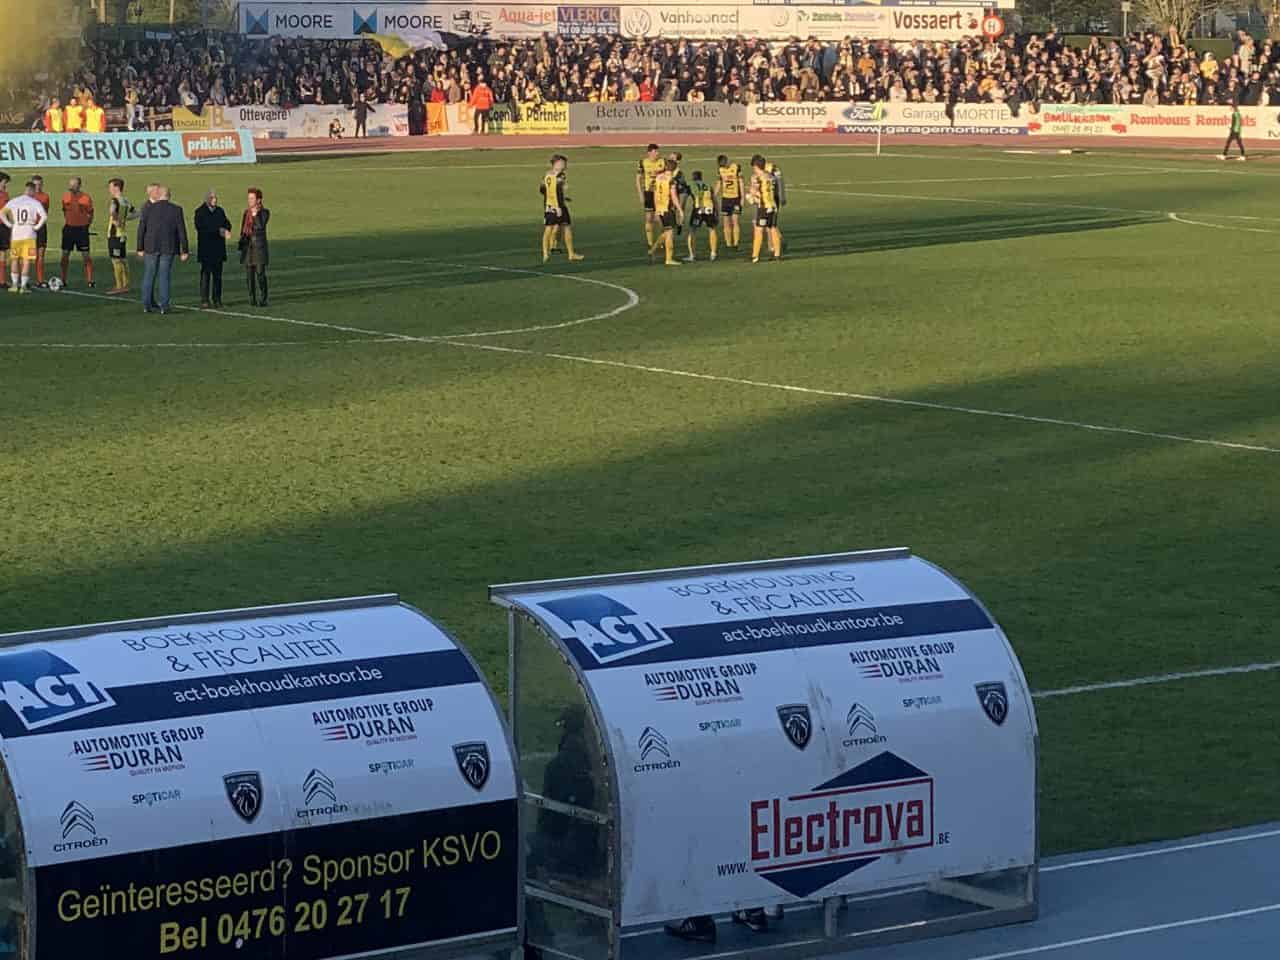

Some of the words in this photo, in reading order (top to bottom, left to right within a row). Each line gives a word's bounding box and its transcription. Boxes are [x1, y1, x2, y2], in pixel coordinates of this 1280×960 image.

[275, 14, 334, 29] MOORE
[384, 15, 443, 29] MOORE
[559, 8, 620, 22] VLERICK
[893, 10, 962, 29] Vossaert
[526, 105, 567, 122] Partners
[596, 104, 633, 119] Beter
[756, 103, 826, 120] descamps
[956, 107, 1010, 121] MORTIE
[1196, 114, 1256, 127] Rombts
[844, 125, 1019, 136] www.garagemortier.be
[32, 140, 58, 162] EN
[69, 138, 172, 161] SERVICES
[16, 208, 29, 223] 10
[670, 570, 856, 598] BOEKHOUDING
[711, 599, 733, 616] &
[736, 586, 865, 614] FISCALITEIT
[122, 619, 337, 652] BOEKHOUDING
[570, 616, 657, 649] ACT
[722, 612, 905, 642] act-boekhoudkantoor.be
[166, 655, 190, 672] &
[197, 638, 344, 669] FISCALITEIT
[849, 644, 919, 664] AUTOMOTIVE
[920, 642, 955, 656] GROUP
[644, 665, 718, 686] AUTOMOTIVE
[720, 662, 758, 677] GROUP
[880, 657, 941, 678] DURAN
[0, 673, 101, 712] ACT
[174, 665, 383, 704] act-boekhoudkantoor.be
[676, 679, 741, 700] DURAN
[312, 702, 391, 726] AUTOMOTIVE
[393, 698, 434, 715] GROUP
[74, 731, 159, 754] AUTOMOTIVE
[161, 726, 205, 744] GROUP
[346, 716, 415, 740] DURAN
[110, 744, 183, 770] DURAN
[750, 797, 924, 861] Electrova
[57, 858, 293, 922] Geïnteresseerd?
[303, 848, 415, 891] Sponsor
[422, 830, 501, 869] KSVO
[160, 917, 208, 955] Bel
[217, 907, 285, 944] 0476
[294, 899, 328, 934] 20
[336, 893, 369, 926] 27
[380, 888, 411, 920] 17
